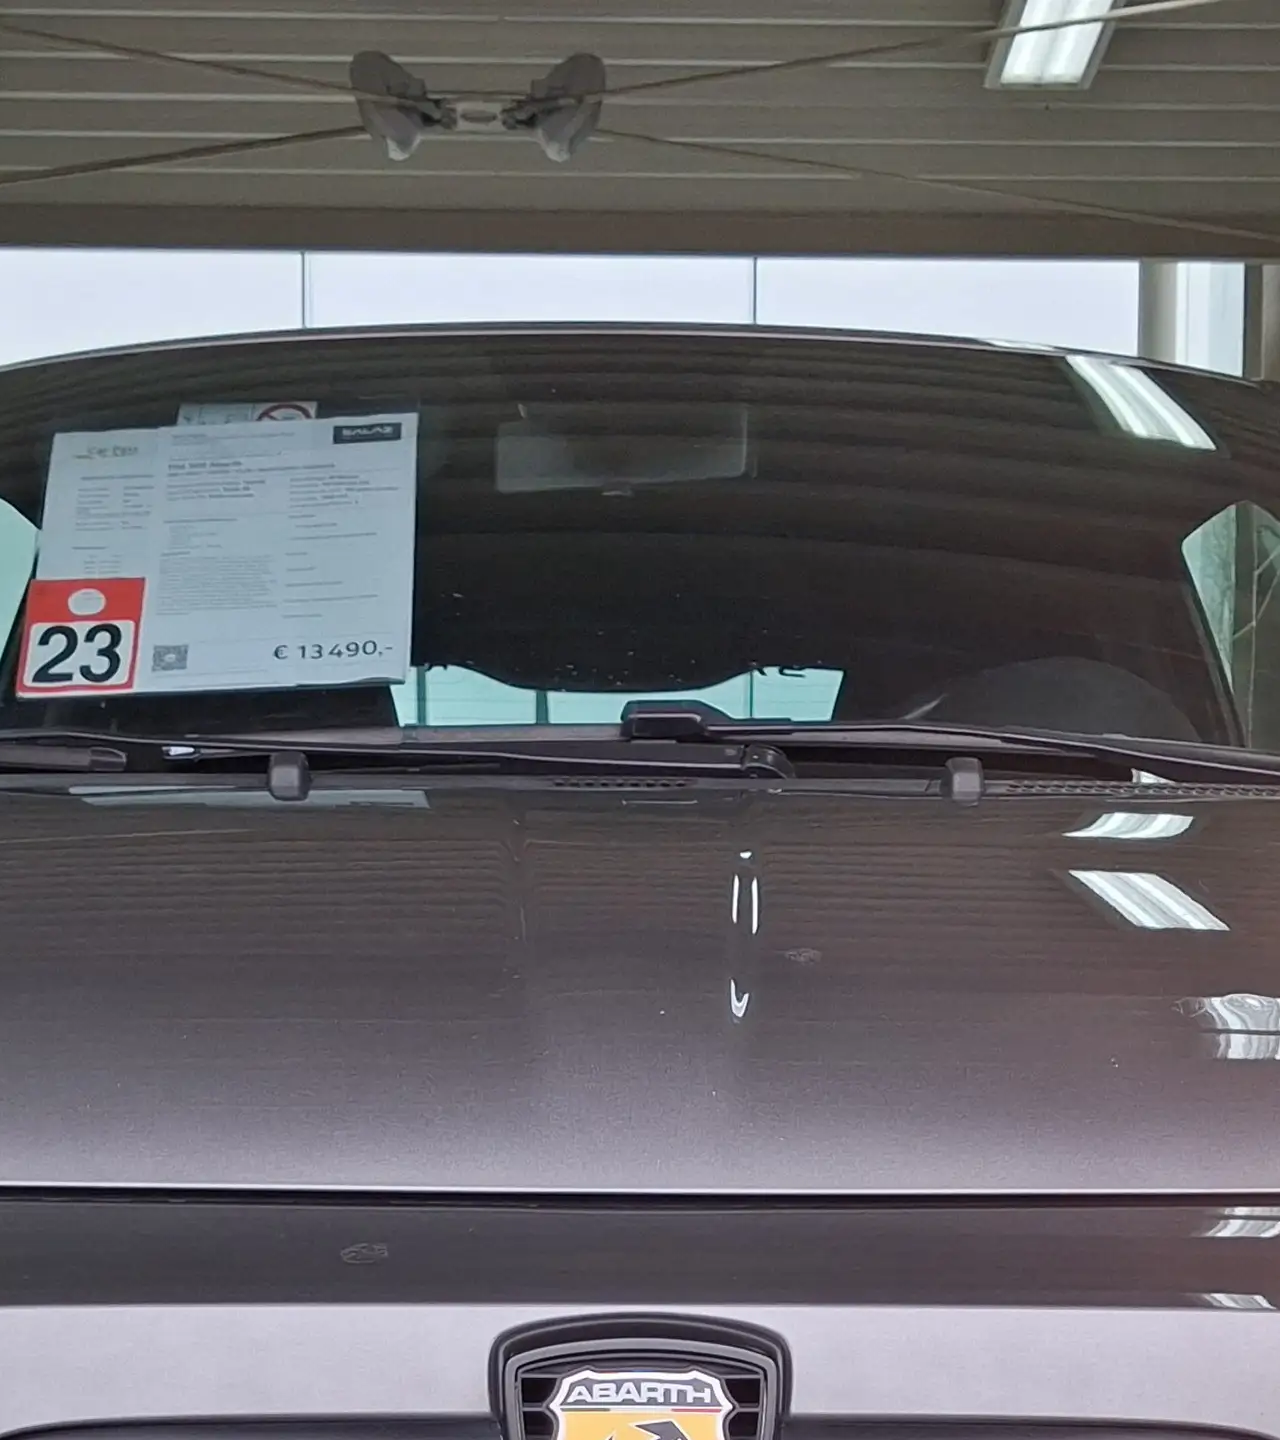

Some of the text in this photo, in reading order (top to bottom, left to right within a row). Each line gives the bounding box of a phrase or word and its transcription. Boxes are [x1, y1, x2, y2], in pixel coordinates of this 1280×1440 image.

[32, 623, 122, 683] 23
[273, 644, 289, 660] €
[567, 1381, 711, 1404] ABARTH
